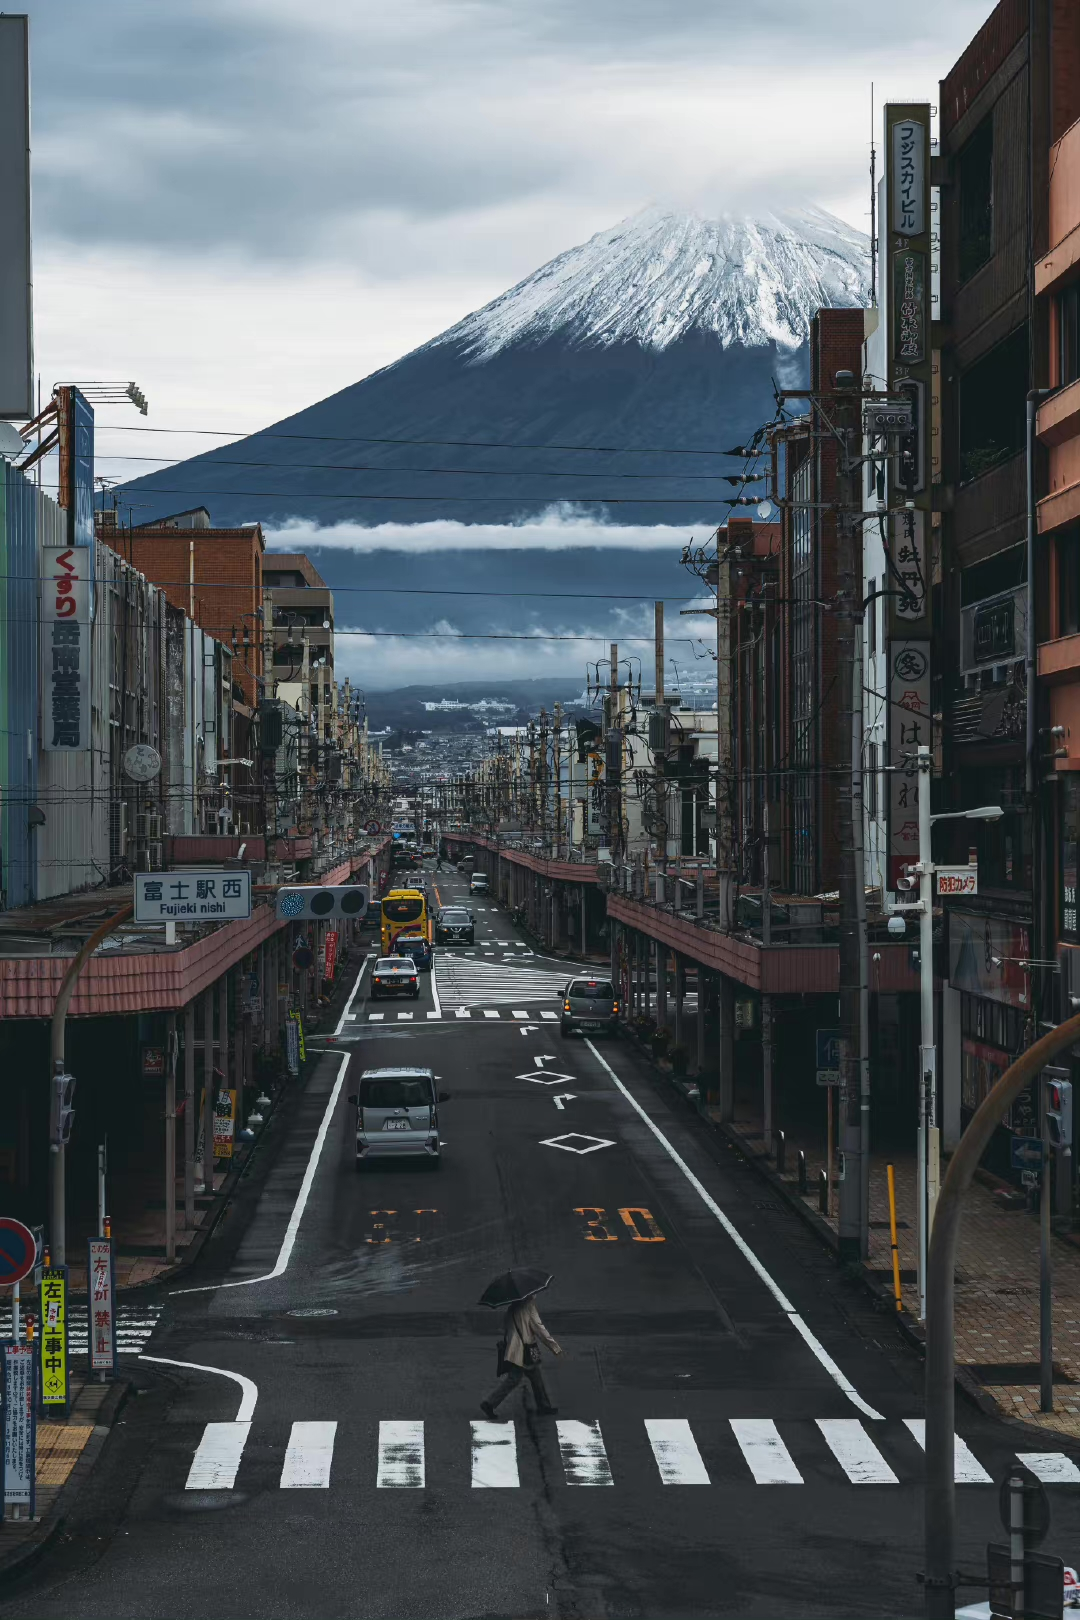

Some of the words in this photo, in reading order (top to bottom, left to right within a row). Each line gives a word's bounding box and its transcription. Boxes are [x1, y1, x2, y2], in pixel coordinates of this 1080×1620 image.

[901, 128, 916, 228] フジスカイビル
[895, 238, 909, 248] 4F
[53, 549, 79, 617] くすり
[52, 620, 80, 747] 岳南堂薬局
[144, 879, 242, 901] 富士駅西
[939, 877, 976, 892] 防犯カメラ
[160, 902, 196, 917] Fujieki
[201, 902, 226, 913] nishi
[573, 1207, 667, 1242] 30
[91, 1245, 109, 1253] この先
[7, 1345, 33, 1354] 工事予告
